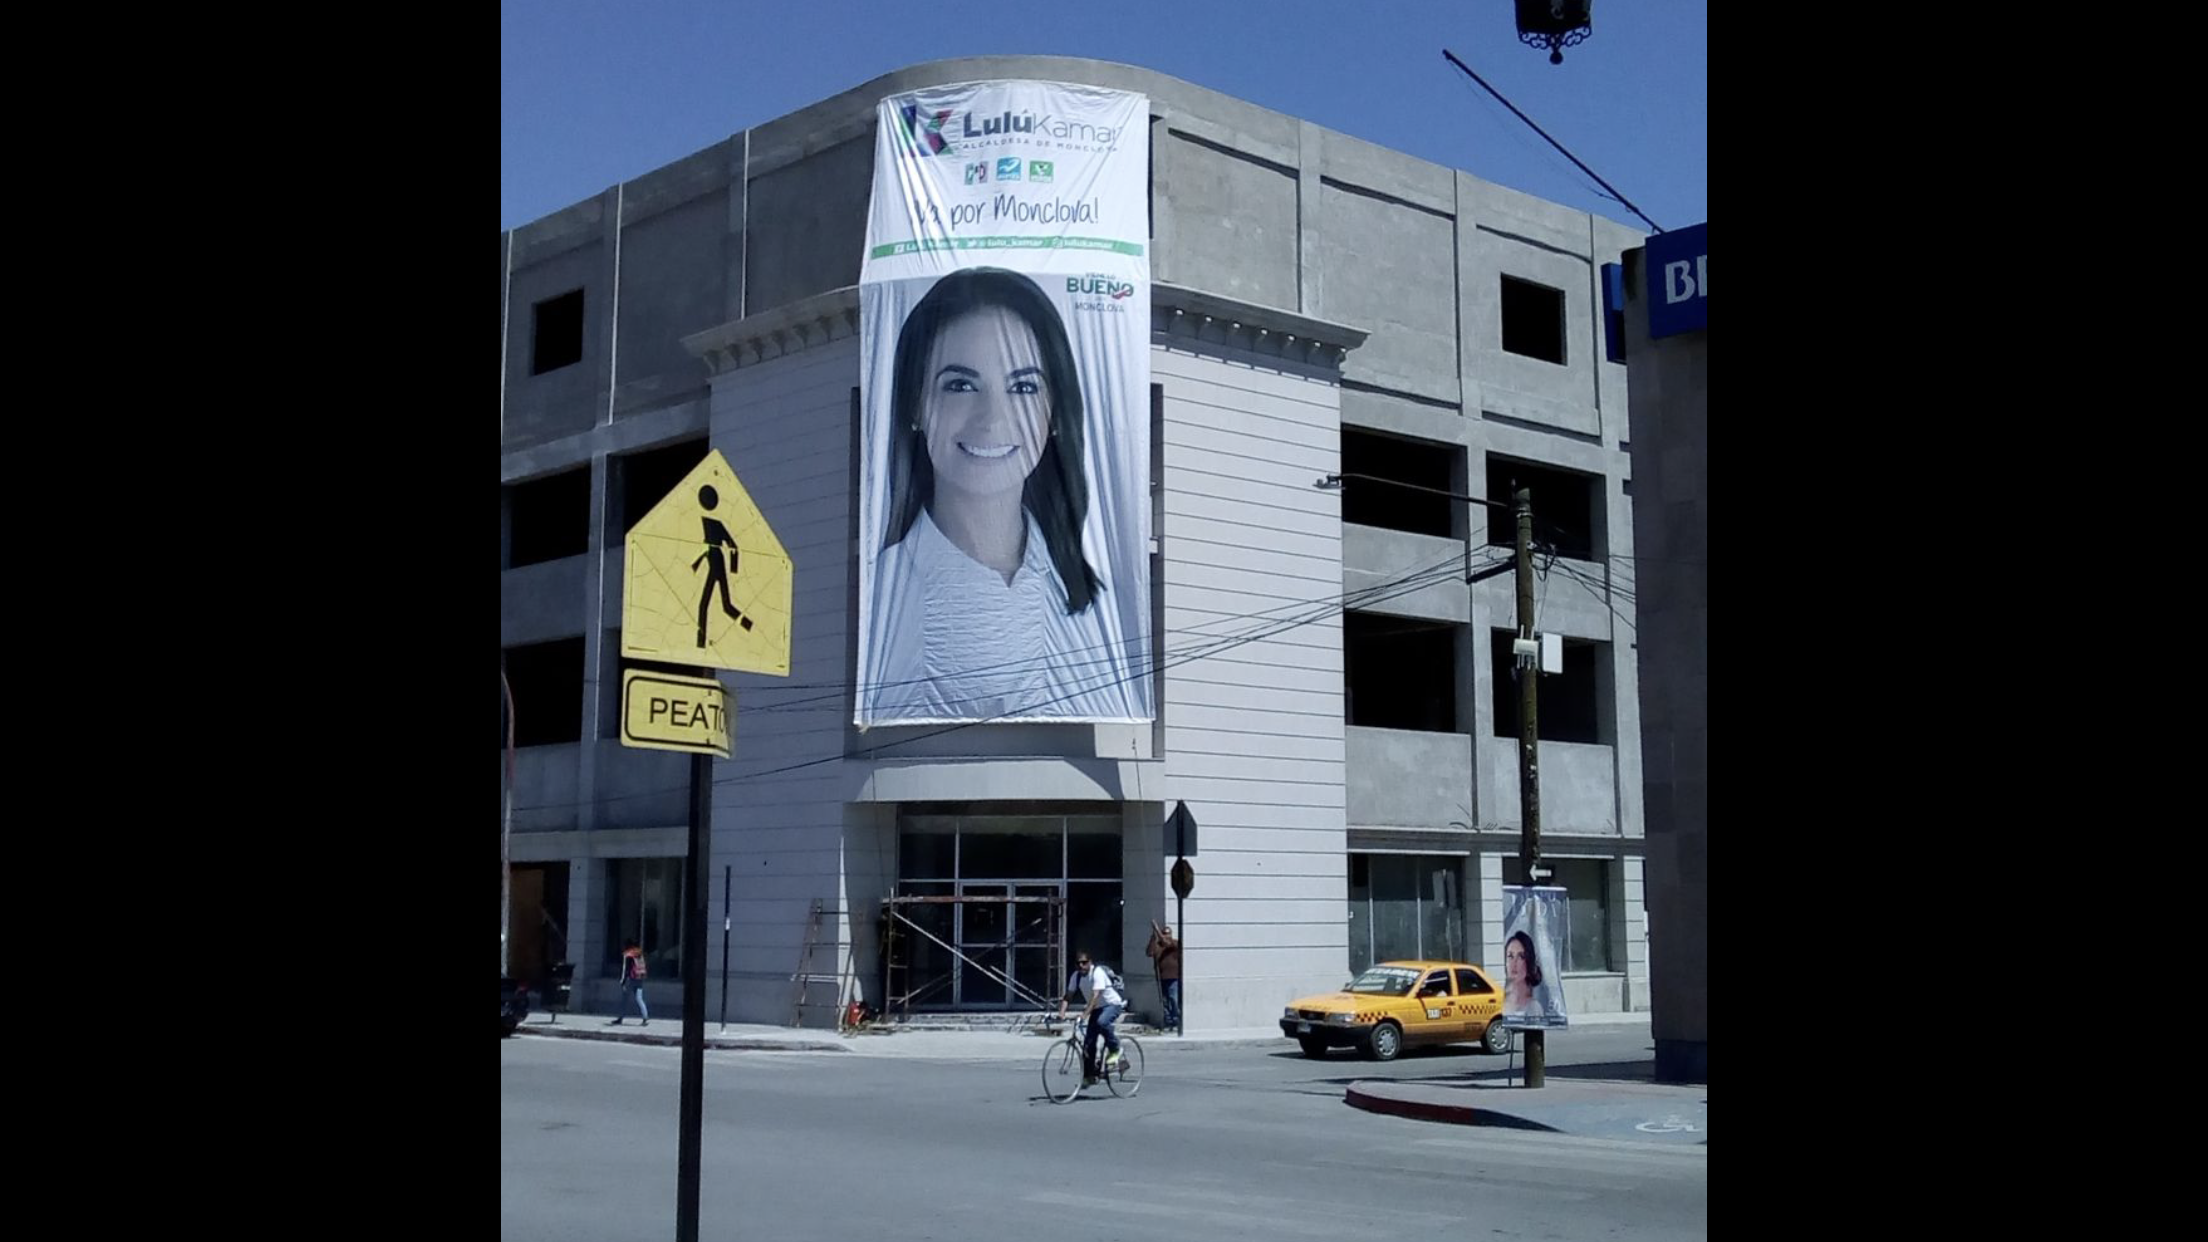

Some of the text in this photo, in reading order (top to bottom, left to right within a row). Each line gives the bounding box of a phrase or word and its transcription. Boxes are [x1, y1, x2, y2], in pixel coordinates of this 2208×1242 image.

[951, 203, 986, 231] por
[994, 193, 1098, 225] Monclova!
[1066, 277, 1134, 297] BUENO
[650, 697, 731, 737] PEATO
